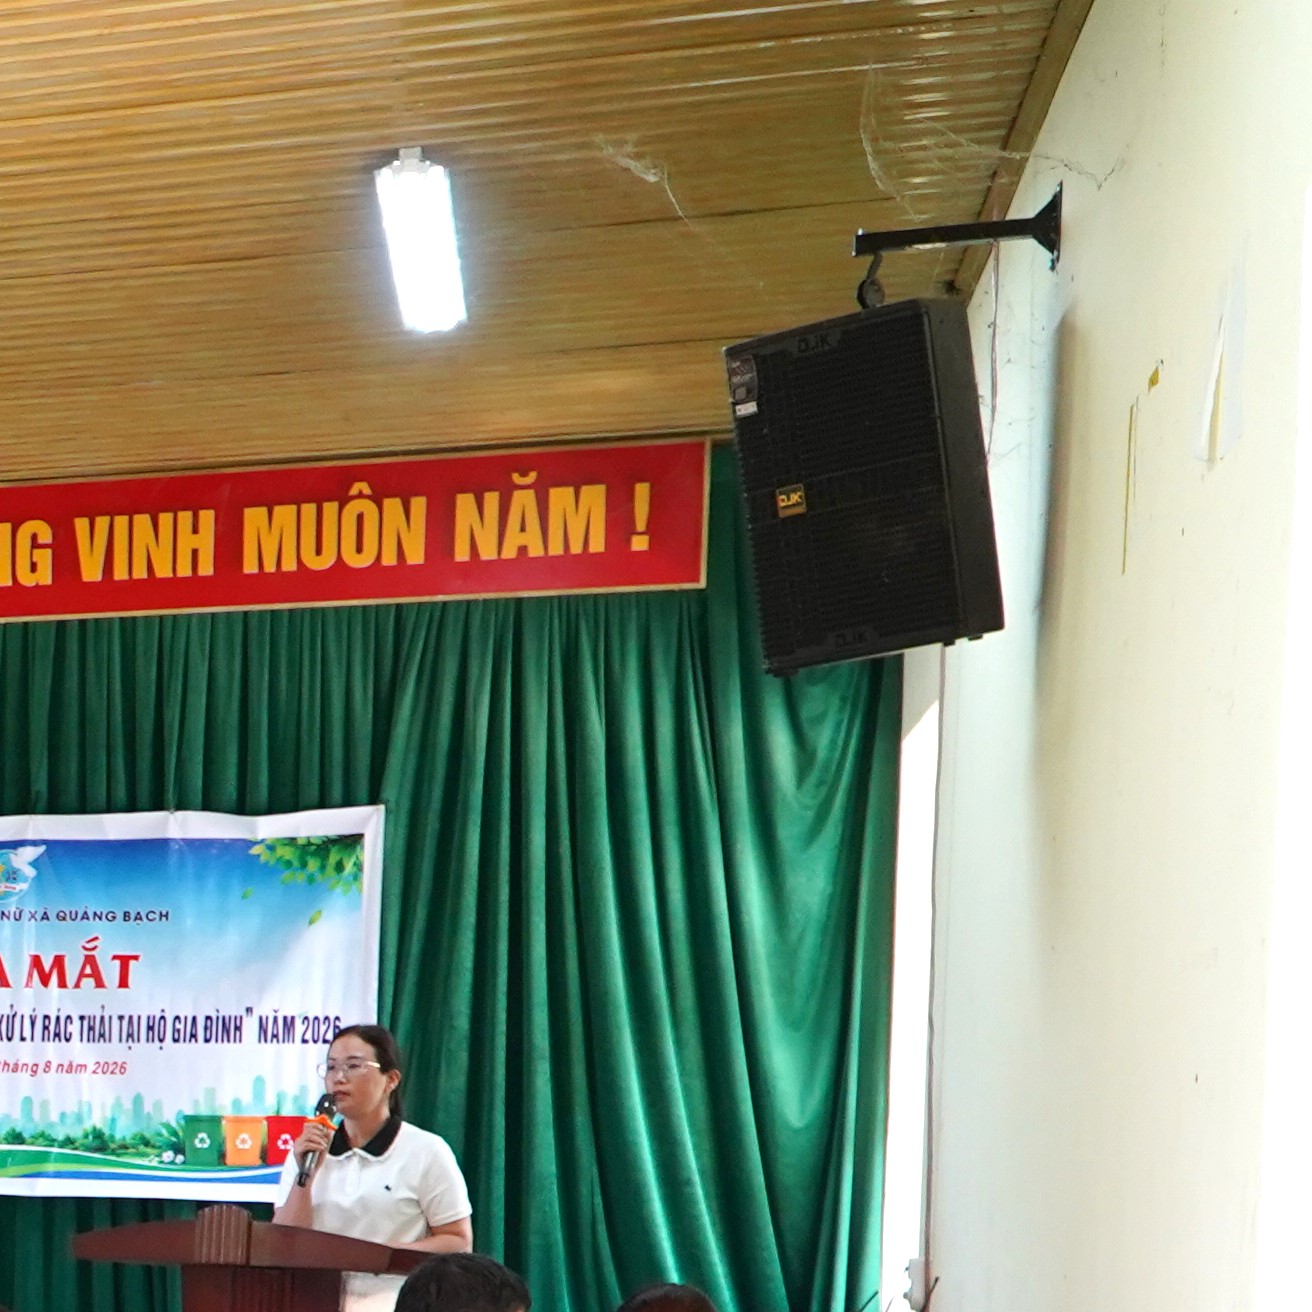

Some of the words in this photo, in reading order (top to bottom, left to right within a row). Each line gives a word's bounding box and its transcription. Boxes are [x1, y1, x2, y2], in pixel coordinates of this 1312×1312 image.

[73, 508, 216, 583] VINH
[241, 481, 428, 575] MUÔN
[453, 470, 608, 564] NĂM
[629, 482, 652, 553] !
[0, 906, 24, 922] NỮ
[28, 907, 51, 922] XÃ
[55, 905, 117, 923] QUẢNG
[122, 909, 170, 926] BẠCH
[24, 935, 141, 990] MẮT
[19, 1007, 38, 1043] LÝ
[42, 1007, 73, 1044] RÁC
[79, 1004, 113, 1044] THẢI
[117, 1014, 140, 1051] TẠI
[145, 1008, 167, 1051] HỘ
[171, 1014, 199, 1044] GIA
[257, 1009, 296, 1044] NĂM
[42, 1060, 52, 1074] 8
[55, 1058, 88, 1075] năm
[91, 1061, 128, 1076] 2026
